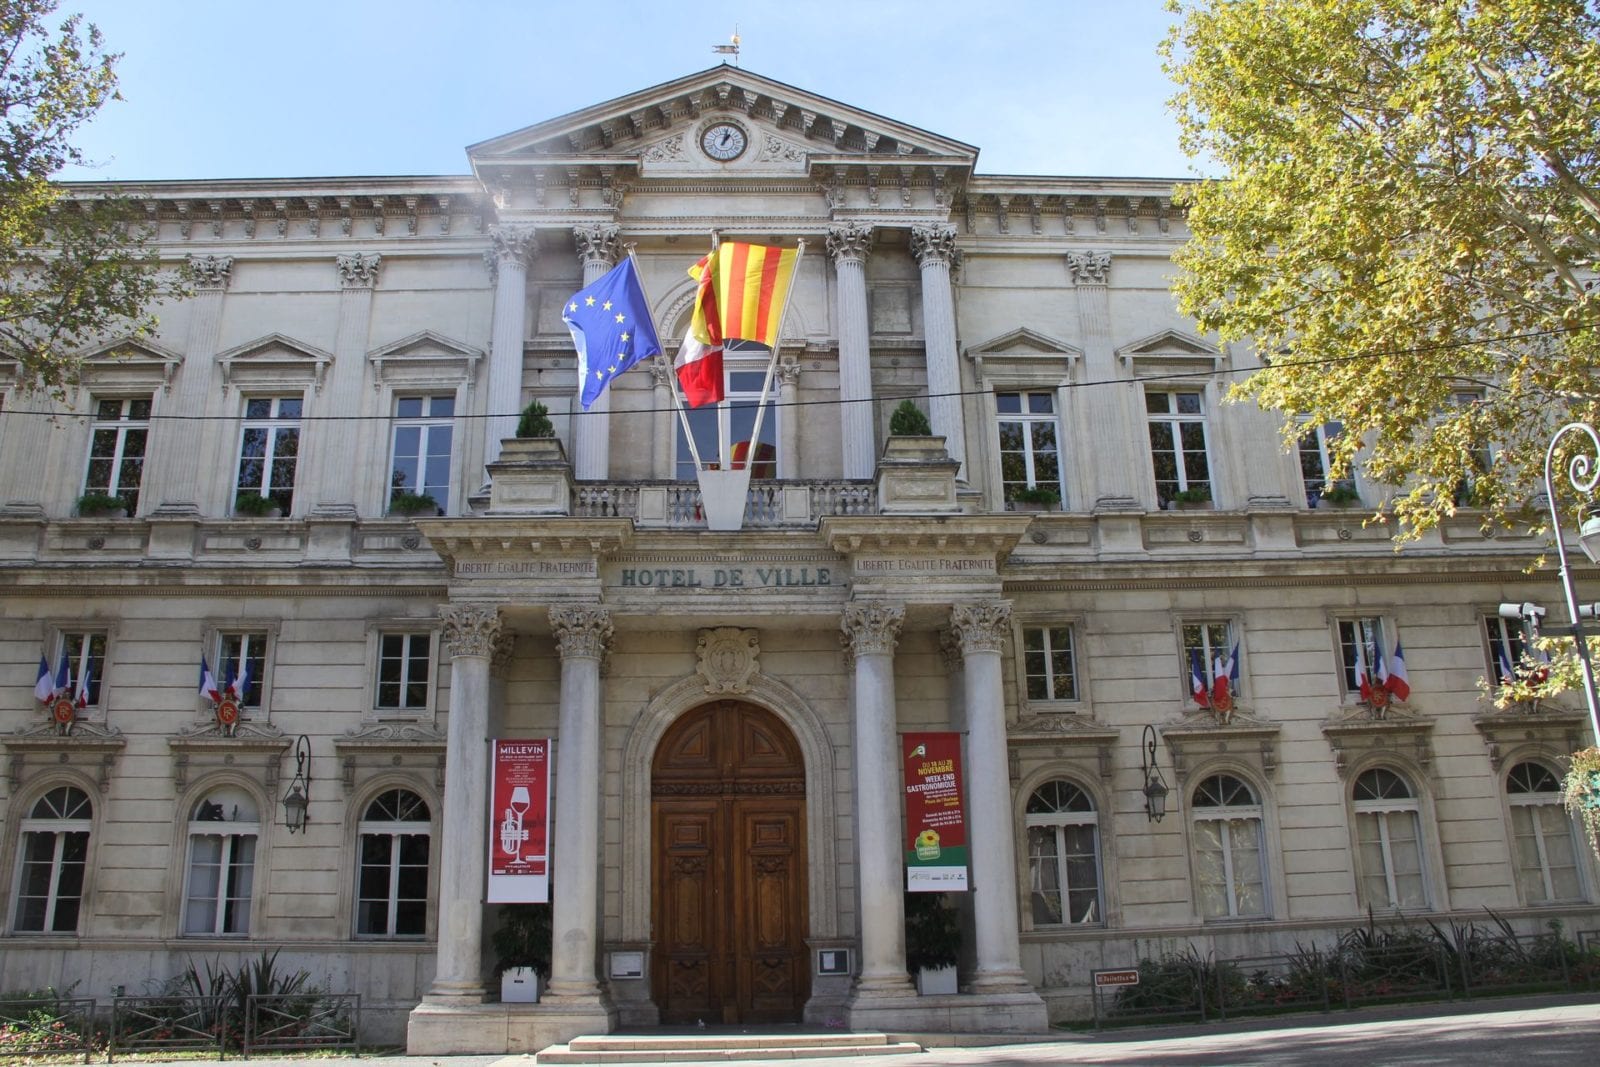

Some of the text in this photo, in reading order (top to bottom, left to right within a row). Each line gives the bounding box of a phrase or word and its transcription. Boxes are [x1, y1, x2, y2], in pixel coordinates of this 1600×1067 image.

[456, 561, 594, 573] LIBERTE EGALITE FRATERNITE
[857, 558, 994, 571] LIBERTE EGALITE FRATERNITE
[621, 568, 831, 587] HOTEL DE VILLE
[500, 746, 544, 754] MILLEVIN
[917, 764, 954, 775] NOVEMBRE
[924, 773, 955, 783] WEEK-END
[906, 781, 957, 793] GASTRONOMIQUE
